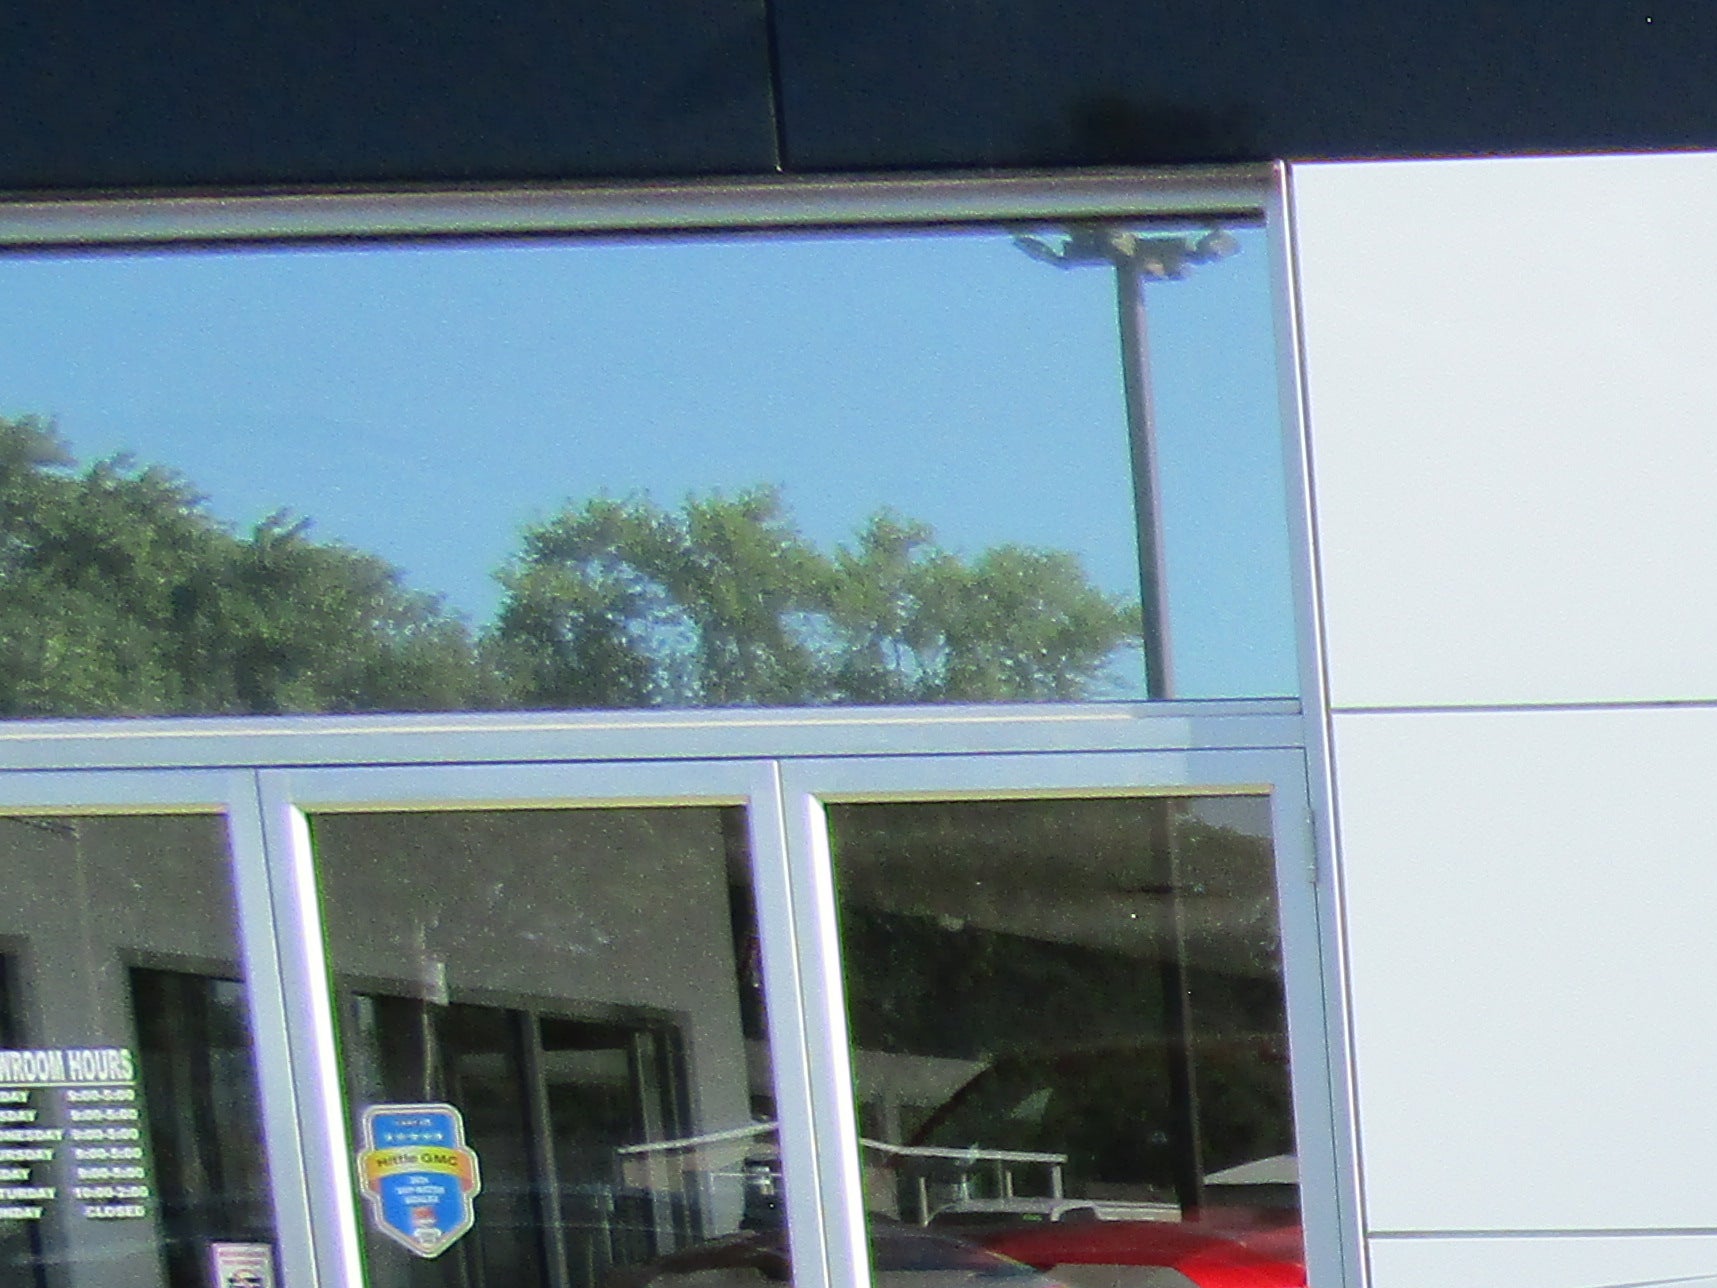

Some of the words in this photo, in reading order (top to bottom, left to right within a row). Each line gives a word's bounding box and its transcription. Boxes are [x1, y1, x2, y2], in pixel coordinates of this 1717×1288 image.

[67, 1048, 133, 1081] HOURS
[420, 1152, 458, 1166] GMC
[84, 1204, 145, 1218] CLOSED
